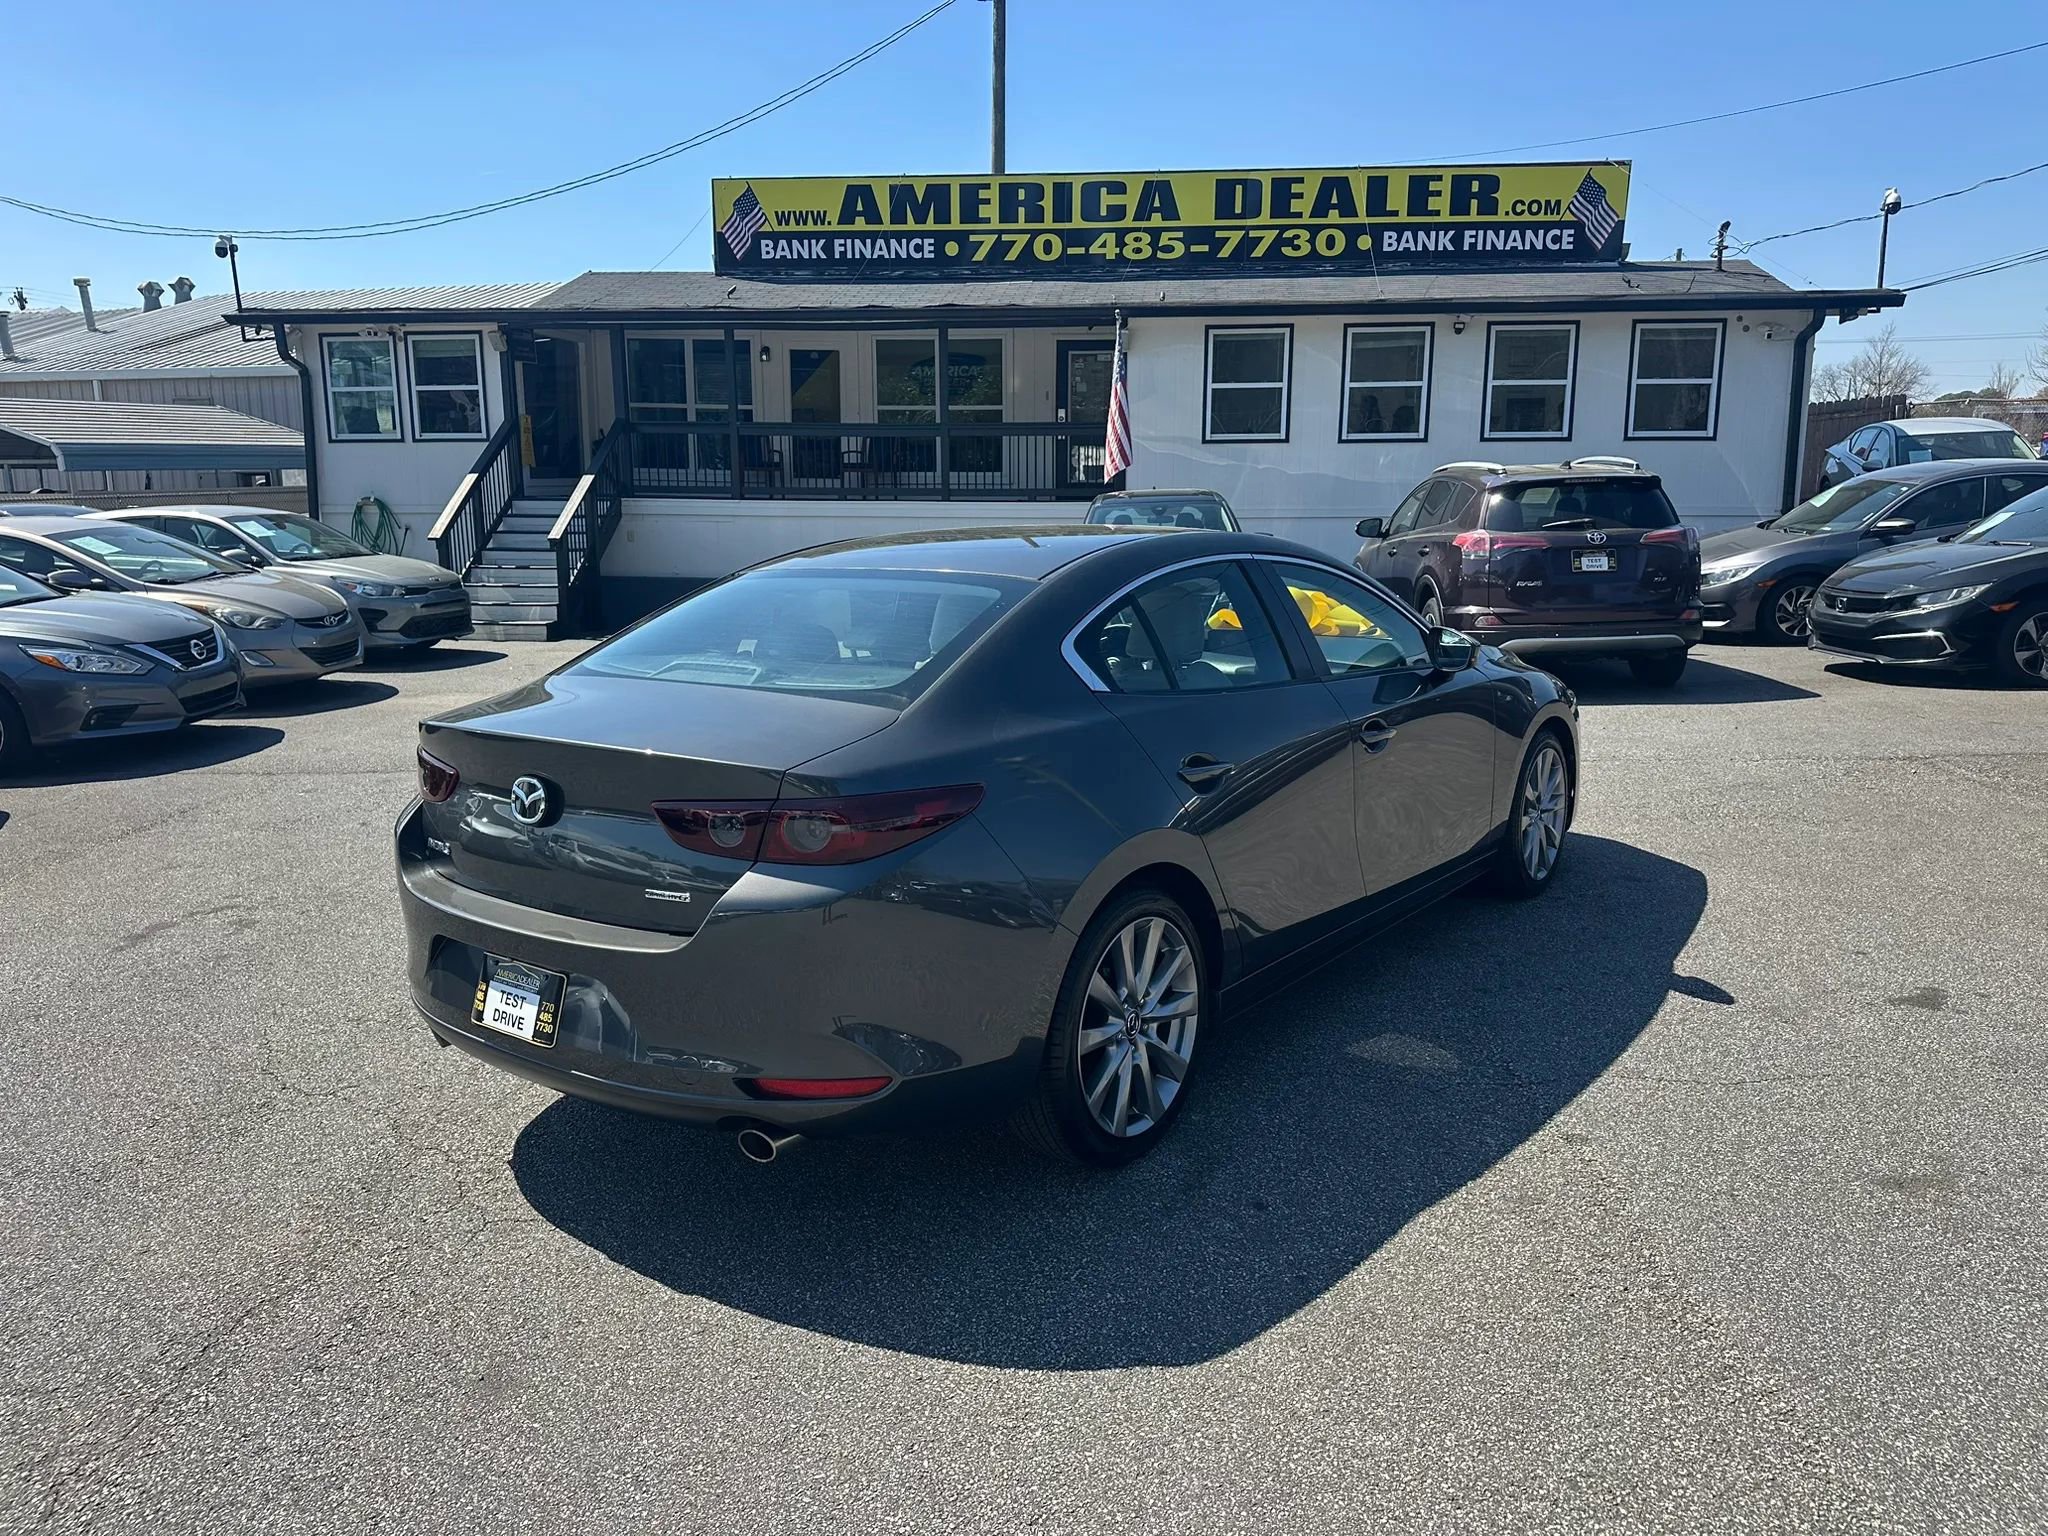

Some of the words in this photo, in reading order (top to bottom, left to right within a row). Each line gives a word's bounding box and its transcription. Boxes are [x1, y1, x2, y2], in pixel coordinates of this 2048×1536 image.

[837, 180, 1182, 226] AMERICA
[1213, 172, 1501, 221] DEALER
[760, 238, 828, 261] BANK
[834, 236, 936, 260] FINANCE
[968, 227, 1347, 262] 770-485-7730
[1382, 230, 1455, 252] BANK
[1463, 228, 1575, 251] FINANCE
[913, 365, 978, 377] AMRICA
[500, 989, 527, 1011] TEST
[541, 1001, 555, 1013] 770
[492, 1007, 525, 1031] DRIVE
[539, 1012, 553, 1023] 485
[536, 1021, 554, 1034] 7730
